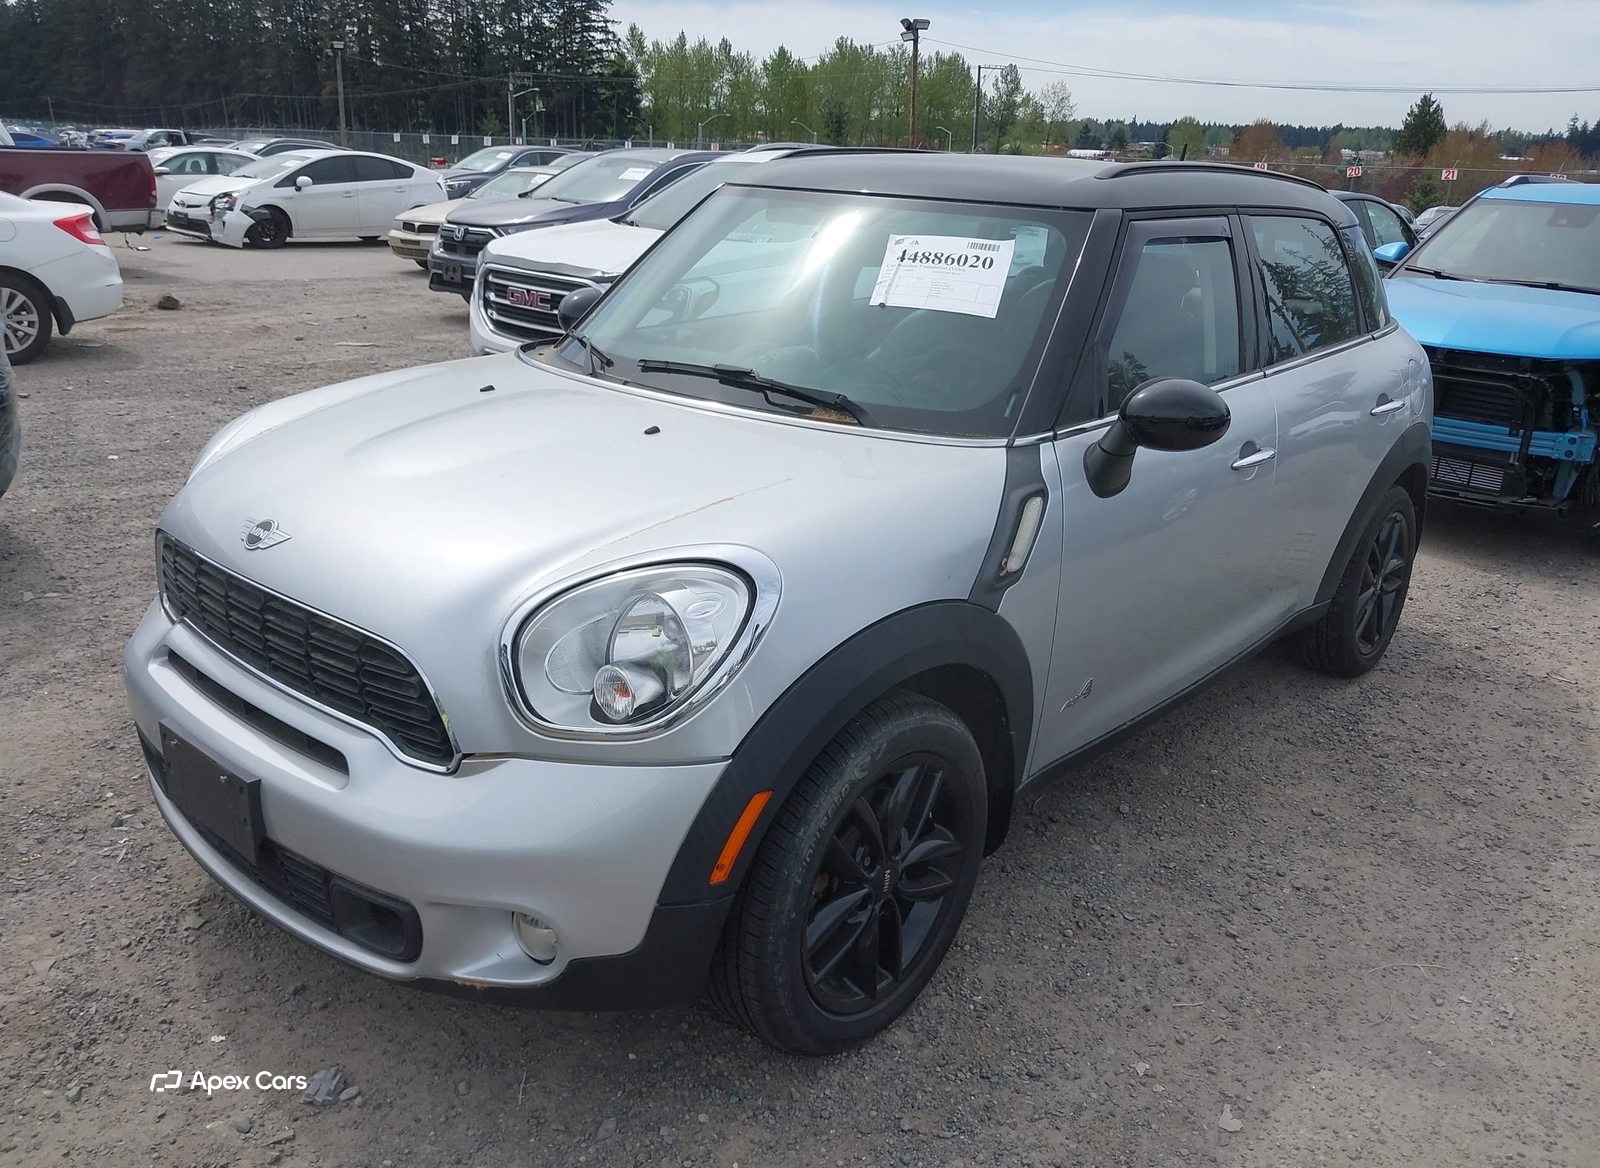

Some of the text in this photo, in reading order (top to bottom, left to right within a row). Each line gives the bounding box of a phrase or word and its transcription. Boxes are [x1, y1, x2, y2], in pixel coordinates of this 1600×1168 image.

[1347, 167, 1360, 176] 20
[1444, 170, 1455, 180] 21
[896, 248, 994, 270] 44886020
[506, 286, 551, 310] GMC
[250, 527, 269, 540] MINI
[882, 869, 891, 893] MINI
